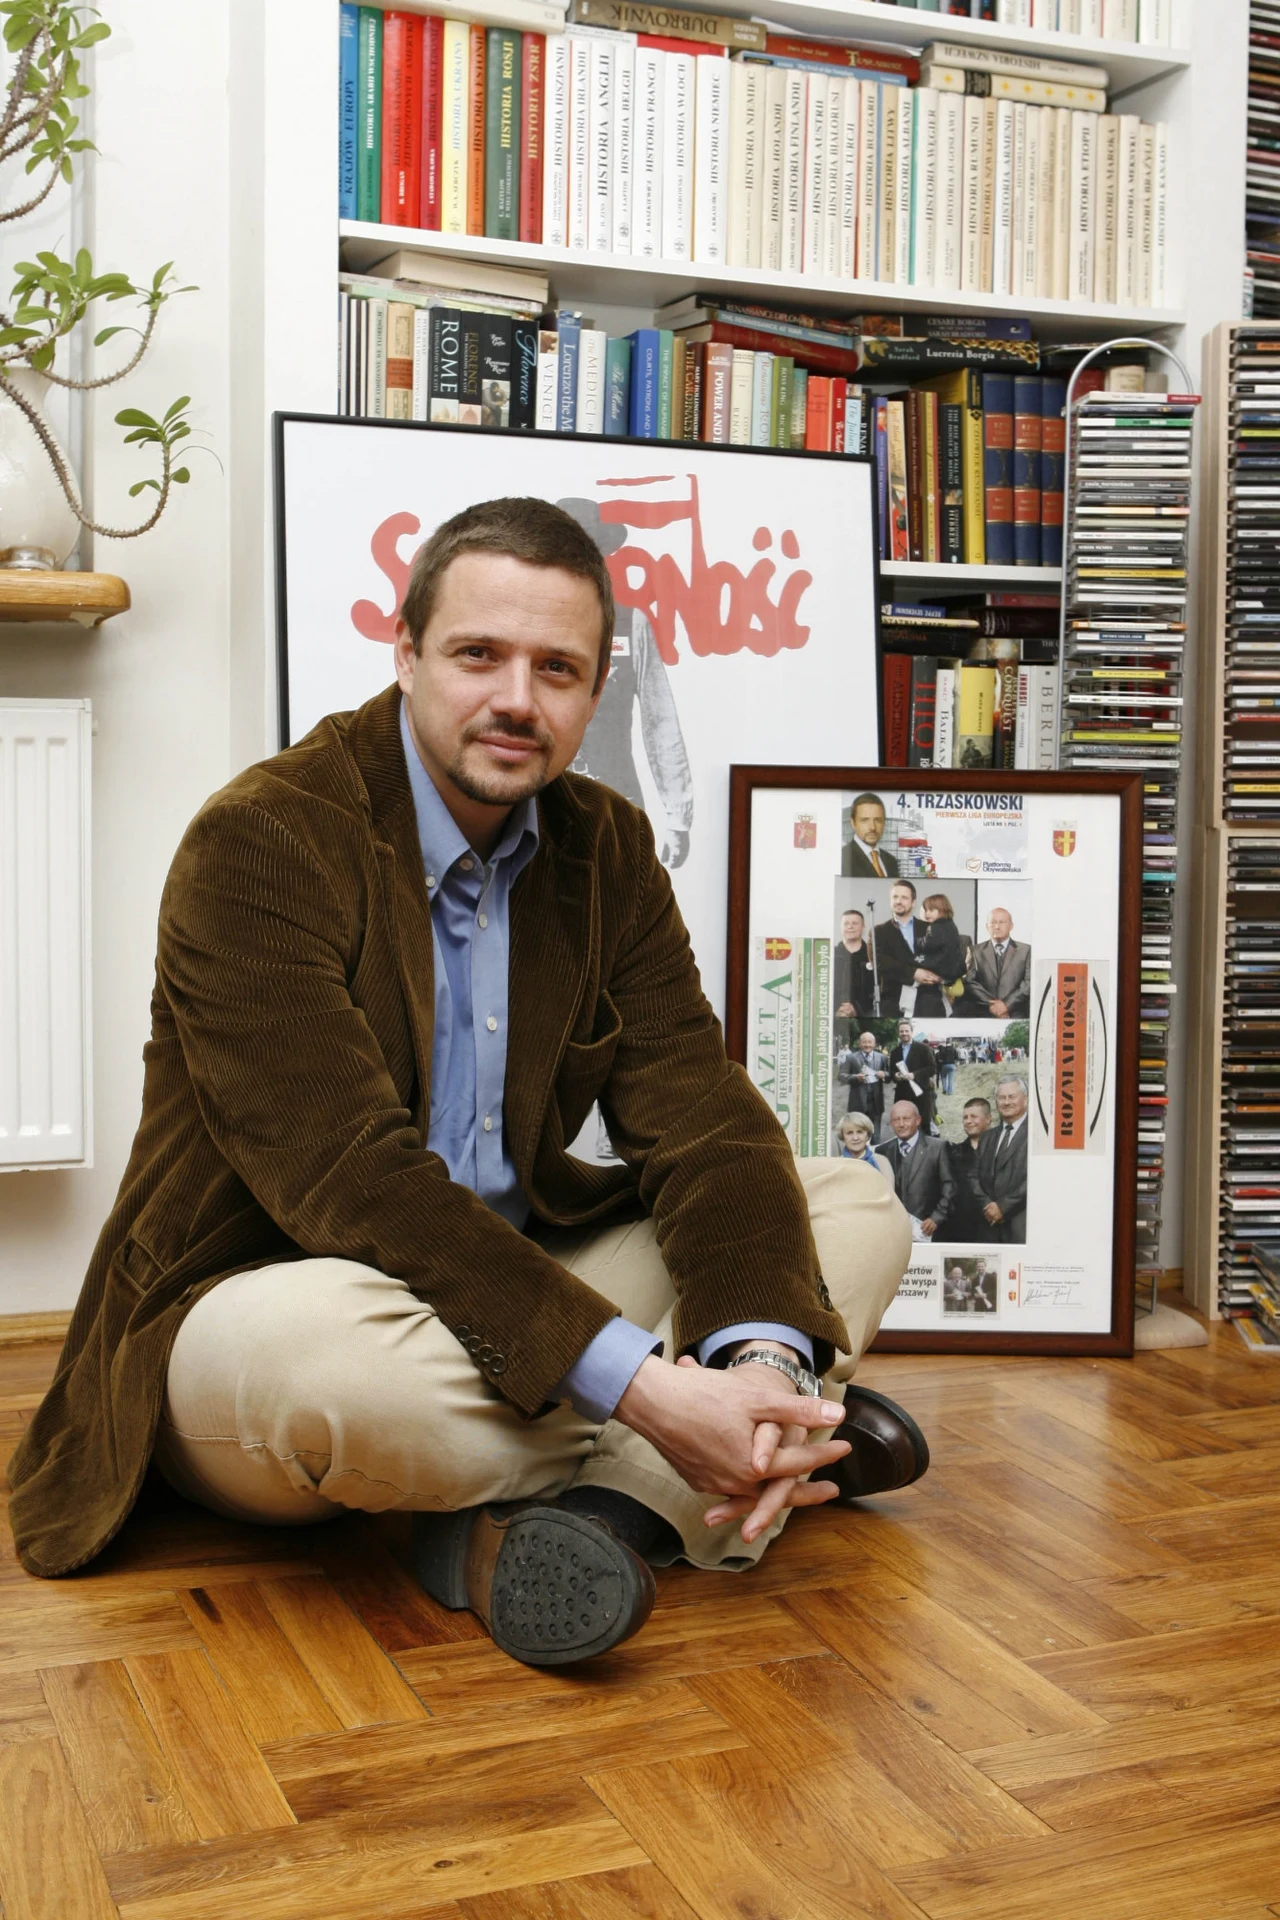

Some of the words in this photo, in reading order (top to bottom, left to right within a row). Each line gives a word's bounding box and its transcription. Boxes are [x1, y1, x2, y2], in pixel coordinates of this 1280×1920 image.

[368, 17, 376, 74] WSCHODNIEJ
[610, 4, 718, 35] DUBROVNIK
[454, 40, 462, 91] UKRAINY
[474, 36, 484, 87] ESTONII
[502, 41, 514, 79] ROSJI
[529, 44, 540, 83] ZSRR
[555, 46, 565, 106] HISZPANII
[577, 50, 586, 105] IRLANDII
[599, 54, 610, 109] ANGLII
[992, 54, 1041, 70] HISTORIA
[344, 79, 354, 130] EUROPY
[621, 70, 630, 111] BELGII
[647, 62, 656, 112] FRANCJI
[711, 74, 720, 125] NIEMIEC
[746, 71, 756, 126] NIEMIEC
[452, 98, 460, 149] HISTORIA
[473, 92, 483, 152] HISTORIA
[501, 86, 512, 148] HISTORIA
[528, 88, 539, 159] HISTORIA
[554, 110, 564, 166] HISTORIA
[576, 110, 585, 165] HISTORIA
[677, 112, 685, 167] HISTORIA
[773, 102, 783, 161] HOLANDII
[790, 81, 800, 147] FINLANDII
[814, 99, 824, 149] AUSTRII
[886, 107, 895, 148] LITWY
[902, 100, 911, 149] ALBANII
[393, 117, 401, 166] HISTORIA
[597, 121, 608, 196] HISTORIA
[621, 117, 630, 174] HISTORIA
[646, 116, 655, 172] HISTORIA
[711, 128, 719, 183] HISTORIA
[745, 130, 754, 189] HISTORIA
[844, 123, 855, 165] TURCJI
[970, 116, 979, 171] RUMUNII
[984, 111, 994, 179] SZWAJCARII
[1003, 114, 1012, 167] ARMENII
[1081, 127, 1090, 171] ETIOPII
[1106, 128, 1115, 180] MAROKA
[344, 140, 353, 194] KRAJÓW
[789, 151, 799, 213] HISTORIA
[813, 155, 822, 214] HISTORIA
[828, 160, 838, 216] HISTORIA
[866, 154, 874, 206] HISTORIA
[885, 152, 894, 211] HISTORIA
[901, 155, 910, 212] HISTORIA
[925, 162, 935, 221] HISTORIA
[771, 167, 780, 221] HISTORIA
[843, 171, 853, 228] HISTORIA
[946, 177, 955, 226] HISTORIA
[969, 176, 978, 234] HISTORIA
[983, 183, 992, 235] HISTORIA
[1002, 171, 1011, 227] HISTORIA
[1080, 176, 1089, 232] HISTORIA
[1105, 184, 1113, 241] HISTORIA
[1127, 188, 1135, 239] HISTORIA
[1143, 198, 1151, 254] HISTORIA
[440, 320, 460, 393] ROME
[468, 332, 479, 395] FLORENCE
[515, 330, 537, 406] Florence
[562, 343, 576, 395] Lorenzo
[612, 362, 625, 383] The
[645, 348, 653, 378] COURTS,
[686, 349, 696, 371] THE
[926, 349, 963, 358] Lucrezia
[966, 349, 995, 361] Borgia
[542, 364, 554, 424] VENICE
[562, 396, 574, 415] the
[585, 356, 597, 416] MEDICI
[611, 385, 625, 420] Medici
[662, 392, 668, 400] OF
[684, 372, 695, 432] CARDINAL'S
[714, 372, 724, 410] POWER
[848, 404, 858, 419] The
[713, 412, 722, 435] AND
[847, 421, 857, 447] Italian
[948, 448, 954, 458] OF
[954, 477, 960, 485] OF
[948, 509, 956, 549] HIBBERT
[925, 610, 941, 618] BEPPE
[1001, 666, 1013, 732] CONQUEST
[1019, 674, 1028, 706] LISBONNE
[890, 682, 905, 758] AUSTRIANS
[897, 794, 911, 808] 4.
[916, 794, 1023, 810] TRZASKOWSKI
[817, 945, 830, 966] było
[817, 967, 828, 983] nie
[816, 984, 830, 1018] jeszcze
[779, 1008, 789, 1099] REMBERTOWSKA
[816, 1020, 830, 1056] jakiego
[1059, 976, 1076, 1137] ROZMAITOŚCI
[815, 1057, 829, 1090] festyn,
[815, 1093, 825, 1155] embertowski
[897, 1289, 929, 1298] arszawy
[904, 1267, 932, 1275] bertów
